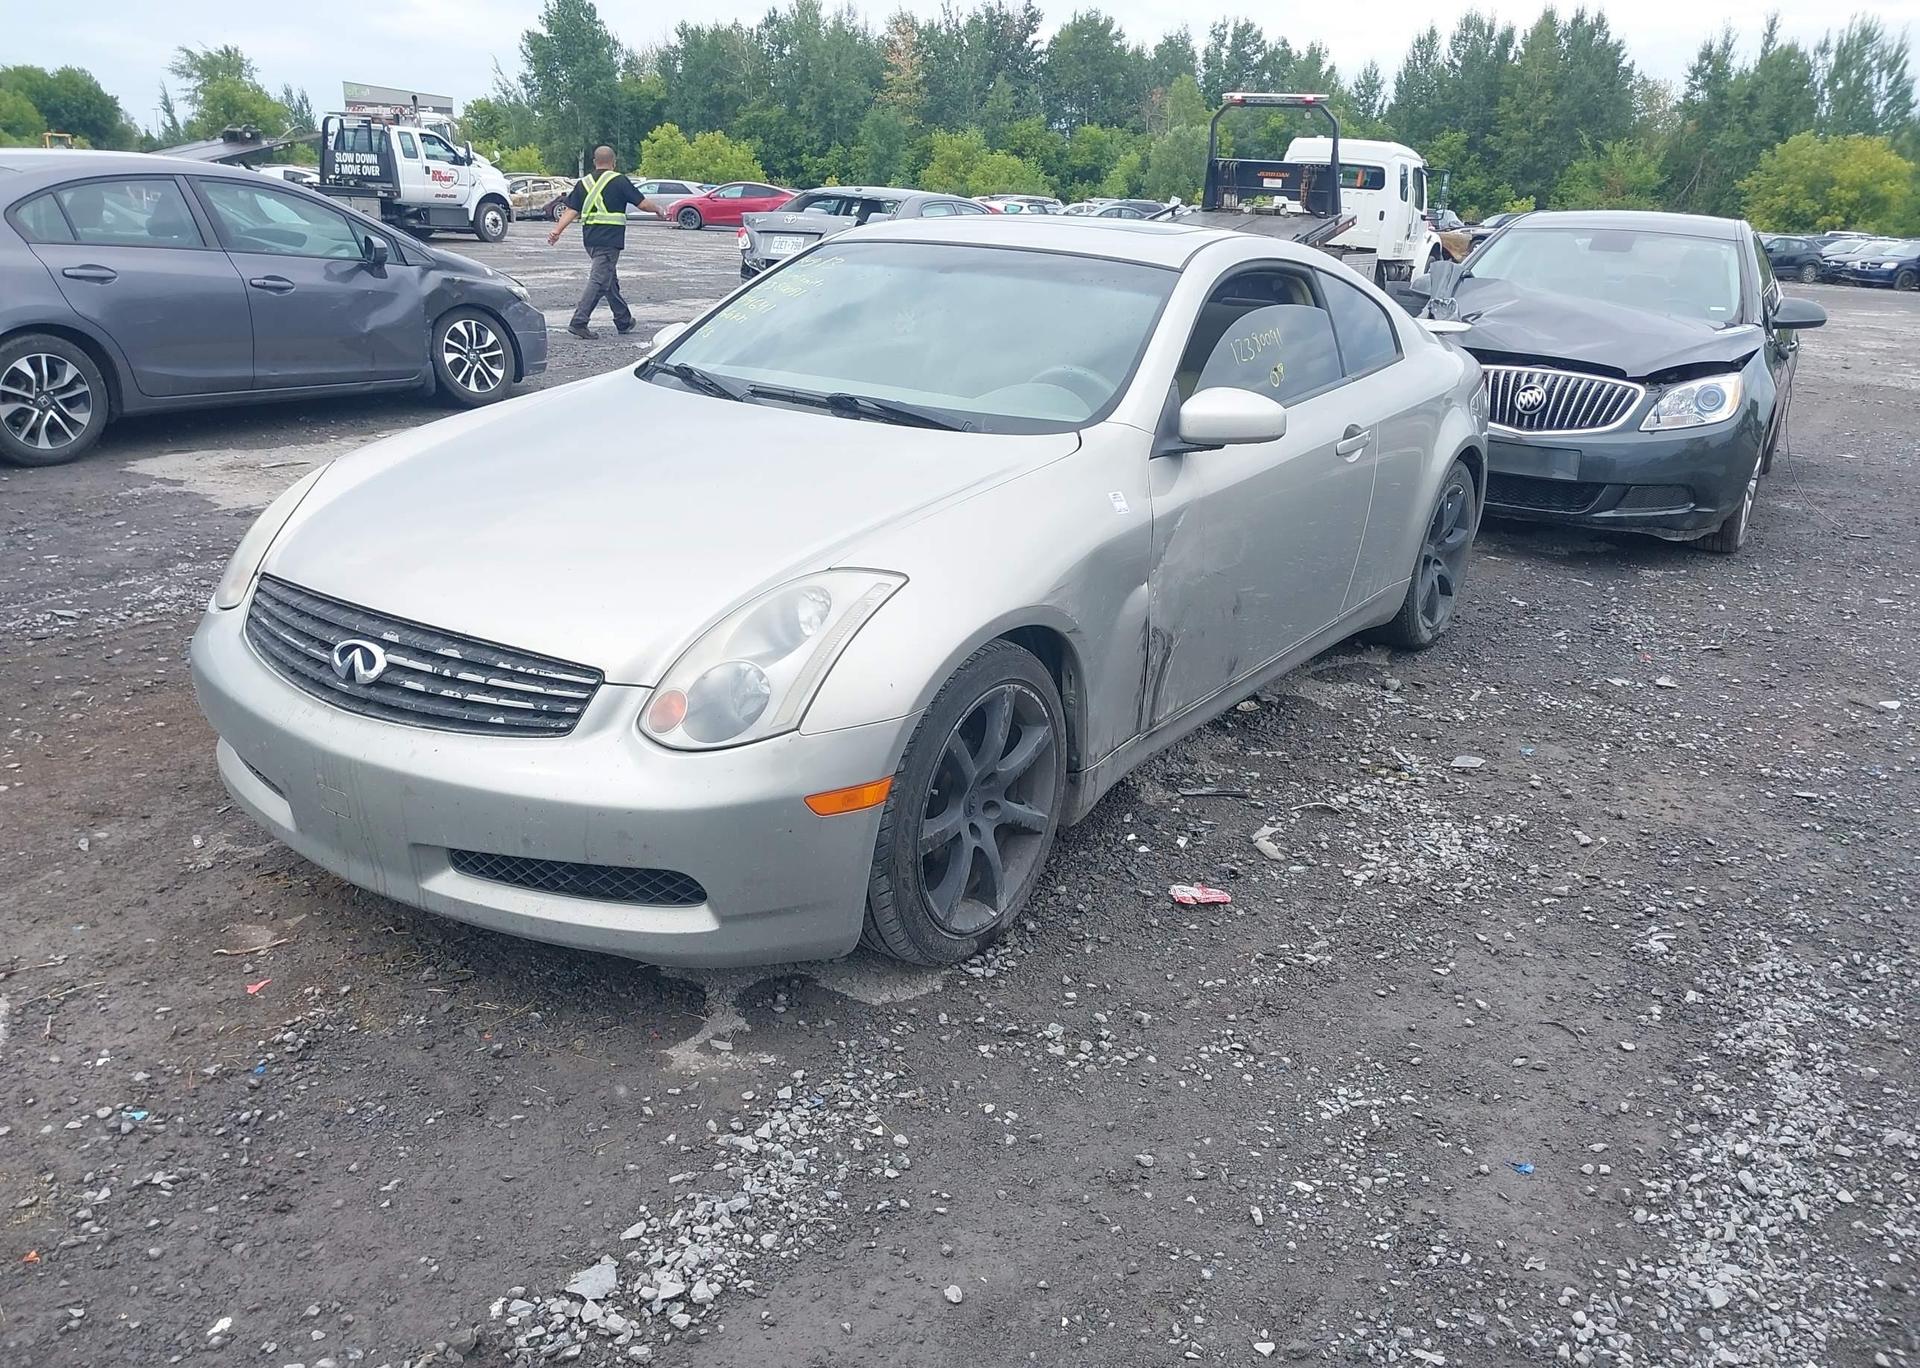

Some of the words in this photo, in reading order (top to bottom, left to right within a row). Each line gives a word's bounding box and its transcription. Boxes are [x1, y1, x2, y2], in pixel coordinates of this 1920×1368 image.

[335, 152, 354, 163] SLOW
[355, 152, 378, 165] DOWN
[334, 163, 340, 175] &
[341, 164, 361, 175] MOVE
[361, 165, 380, 177] OVER
[1230, 327, 1284, 367] 12380091
